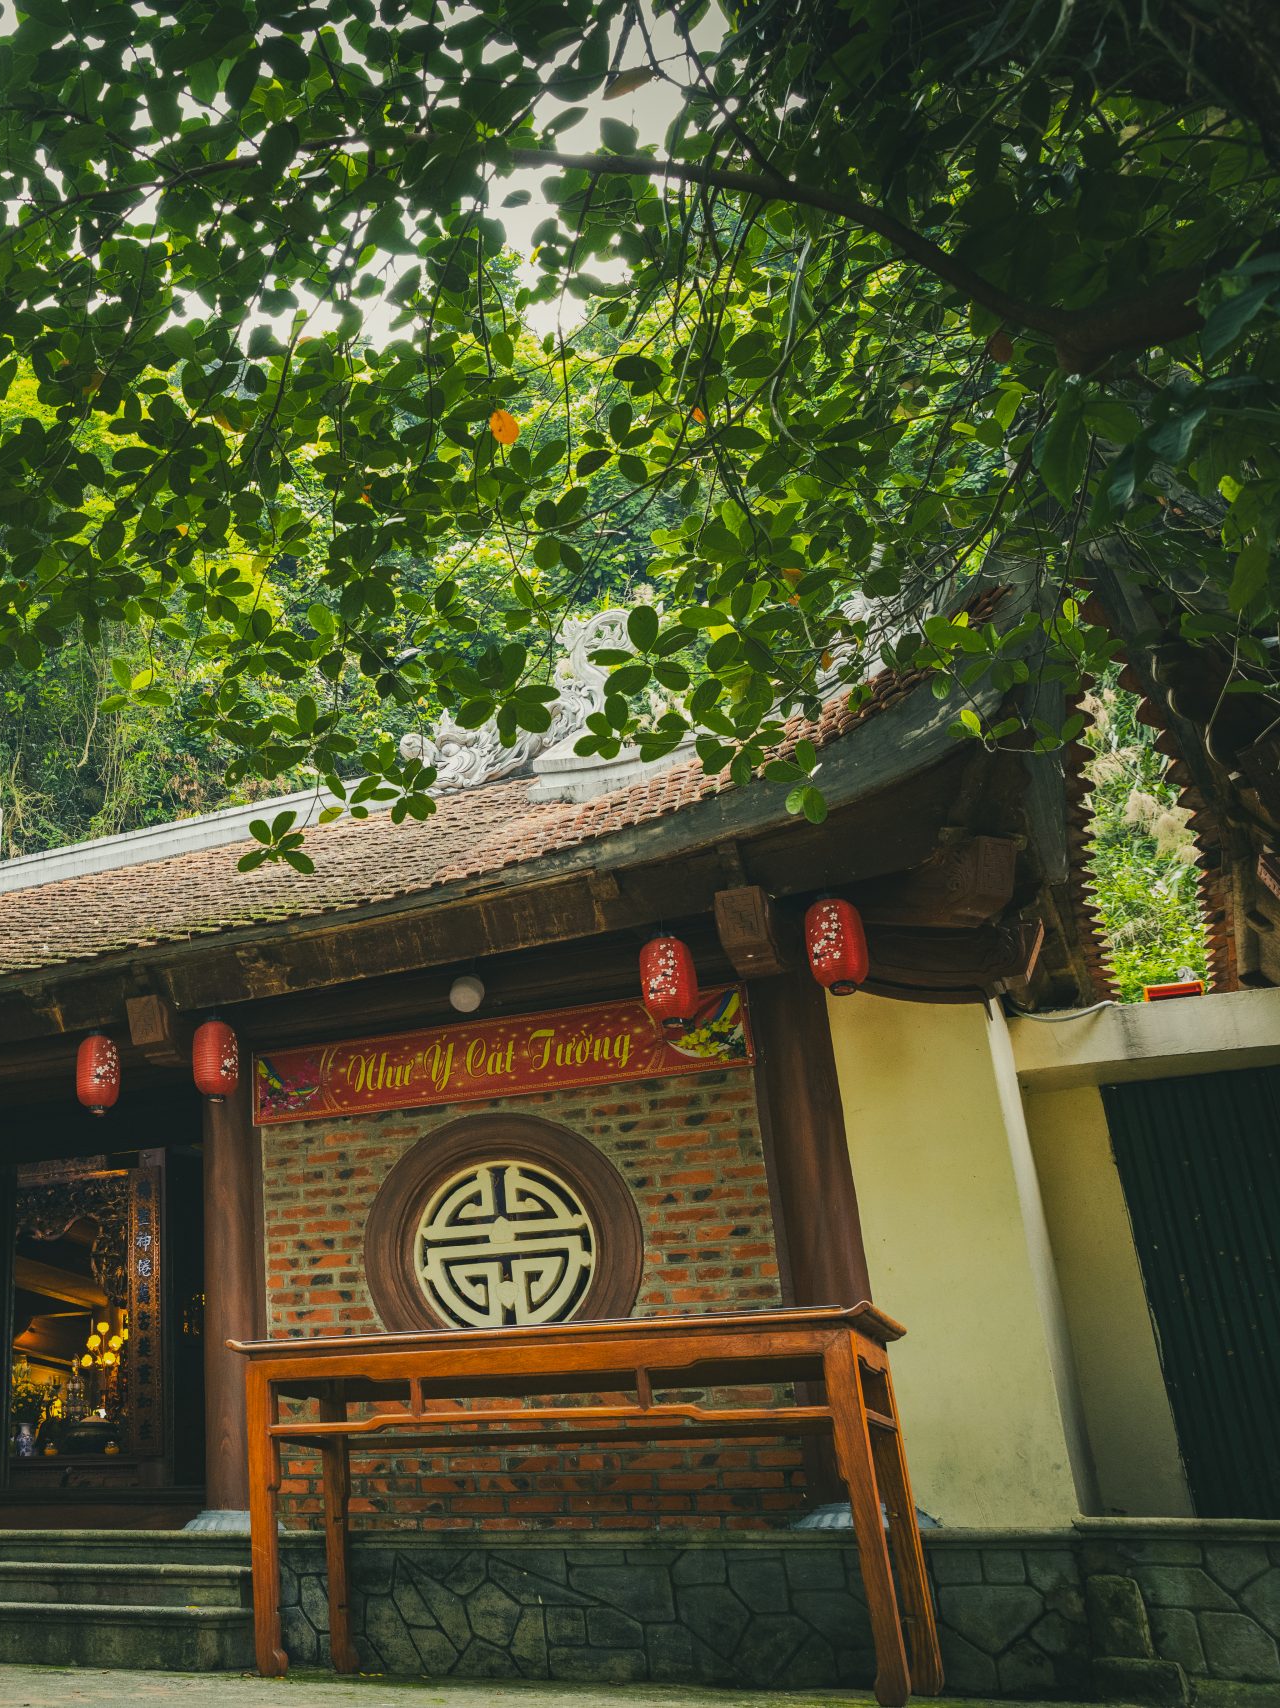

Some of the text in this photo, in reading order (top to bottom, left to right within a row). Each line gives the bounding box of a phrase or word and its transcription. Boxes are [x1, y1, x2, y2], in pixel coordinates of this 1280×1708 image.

[347, 1029, 634, 1093] Như Ý Cát Tường
